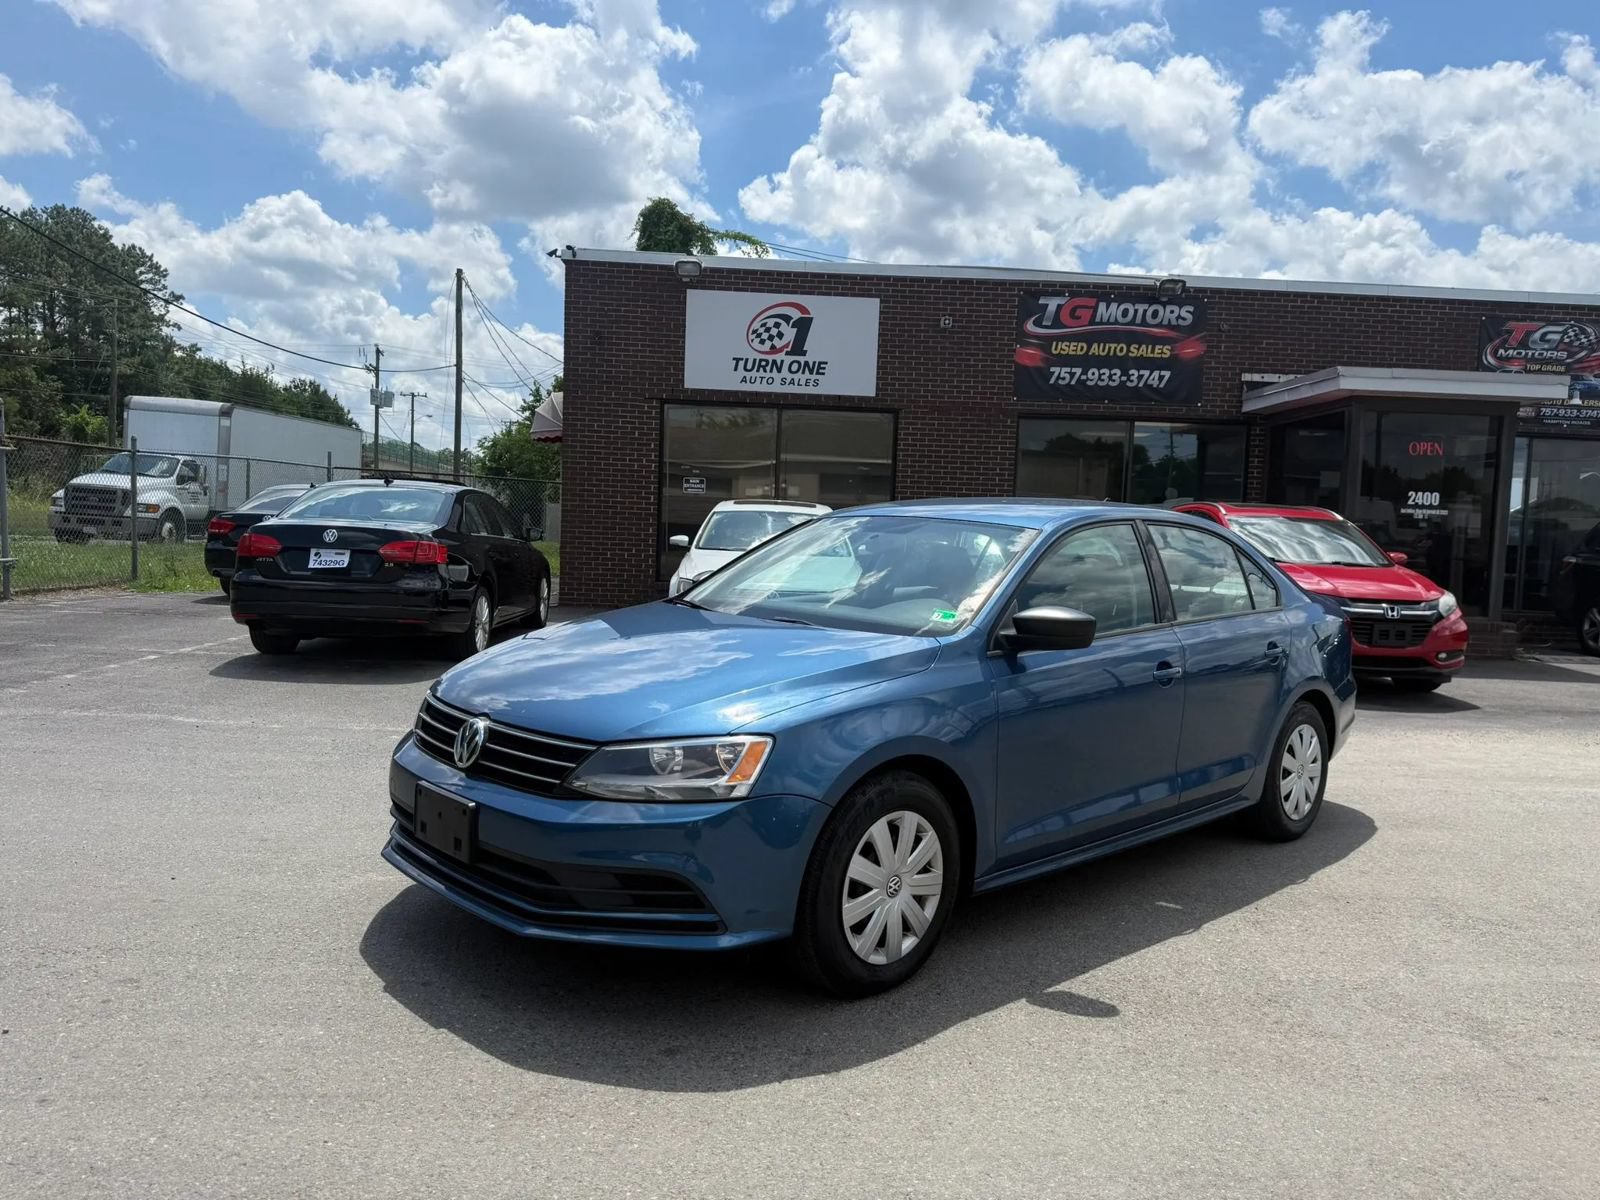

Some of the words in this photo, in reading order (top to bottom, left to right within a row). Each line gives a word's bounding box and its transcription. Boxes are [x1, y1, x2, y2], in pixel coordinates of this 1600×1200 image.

[1038, 296, 1097, 327] TG
[1095, 302, 1194, 326] MOTORS
[1502, 321, 1567, 349] TG
[1051, 341, 1087, 355] USED
[1089, 343, 1127, 357] AUTO
[1128, 344, 1171, 358] SALES
[1497, 348, 1568, 360] MOTORS
[732, 357, 785, 374] TURN
[788, 359, 828, 375] ONE
[1526, 363, 1541, 372] TOP
[1542, 364, 1567, 372] GRADE
[740, 375, 774, 386] AUTO
[780, 377, 820, 387] SALES
[1049, 366, 1171, 388] 757-933-3747
[1408, 441, 1443, 456] OPEN
[1407, 491, 1440, 506] 2400
[313, 558, 345, 567] 74329G
